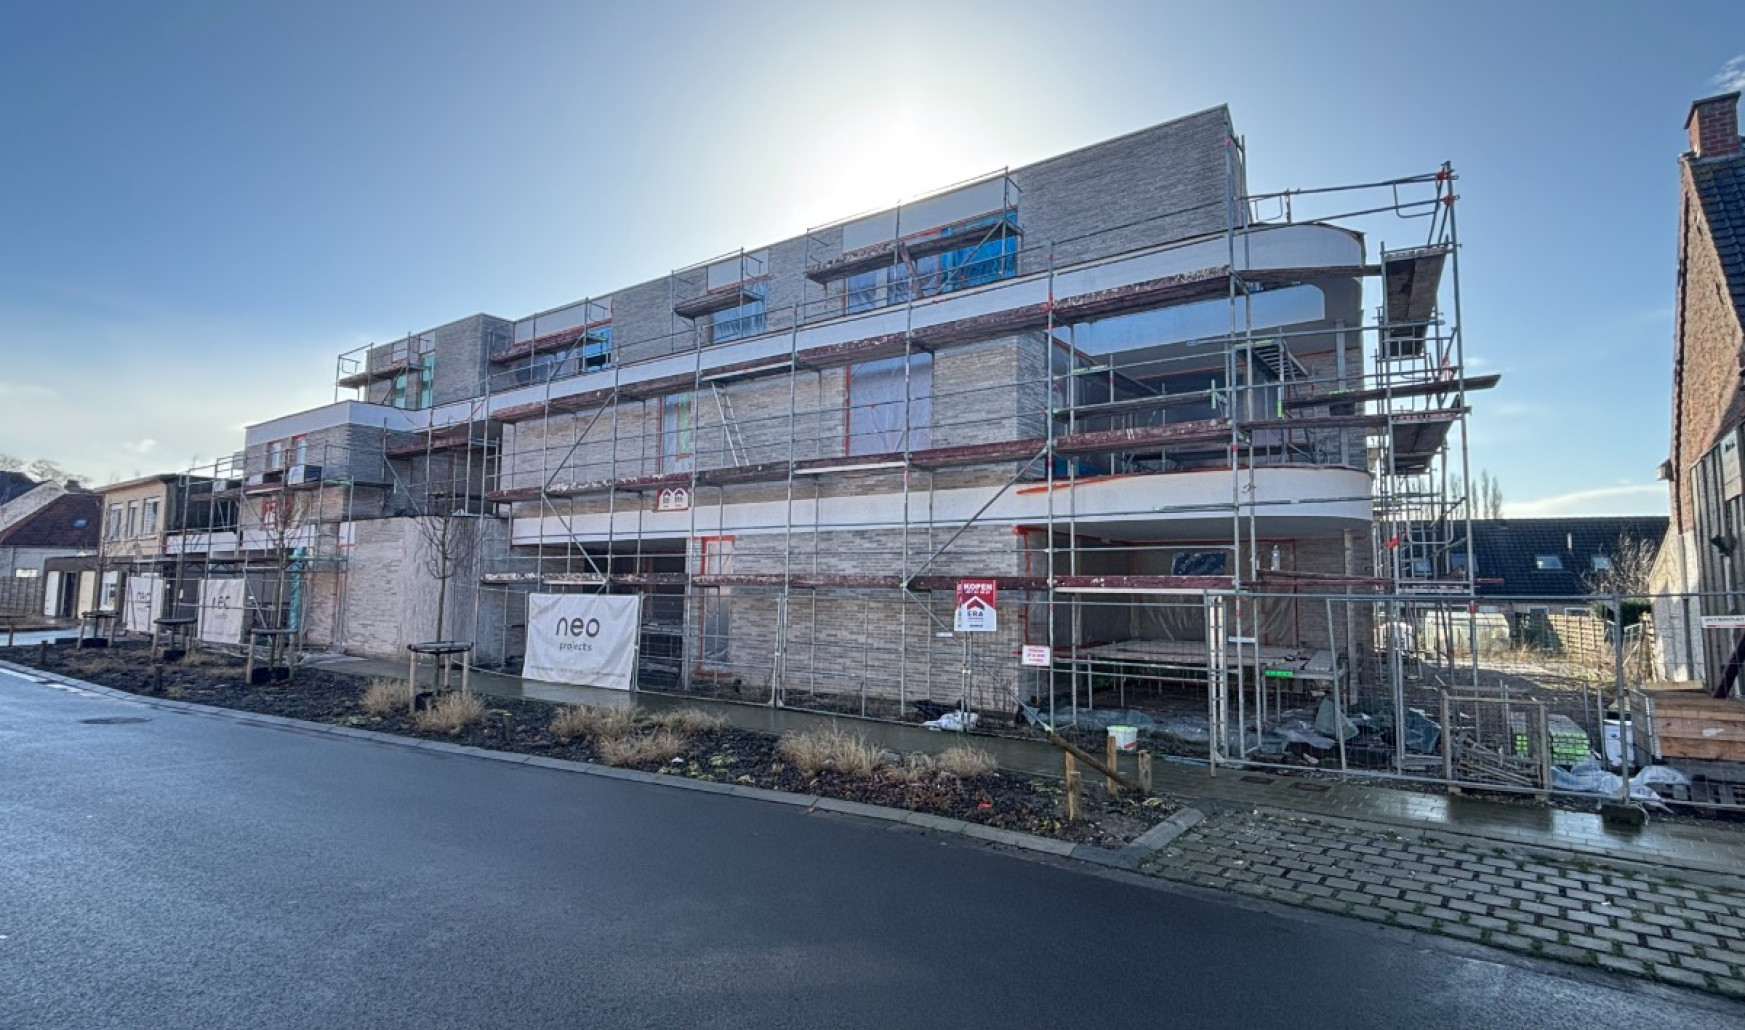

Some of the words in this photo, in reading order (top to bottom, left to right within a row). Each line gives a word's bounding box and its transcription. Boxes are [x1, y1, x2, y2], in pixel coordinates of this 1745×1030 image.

[963, 583, 992, 591] KOPEN
[555, 616, 600, 638] neo
[559, 641, 592, 652] projects
